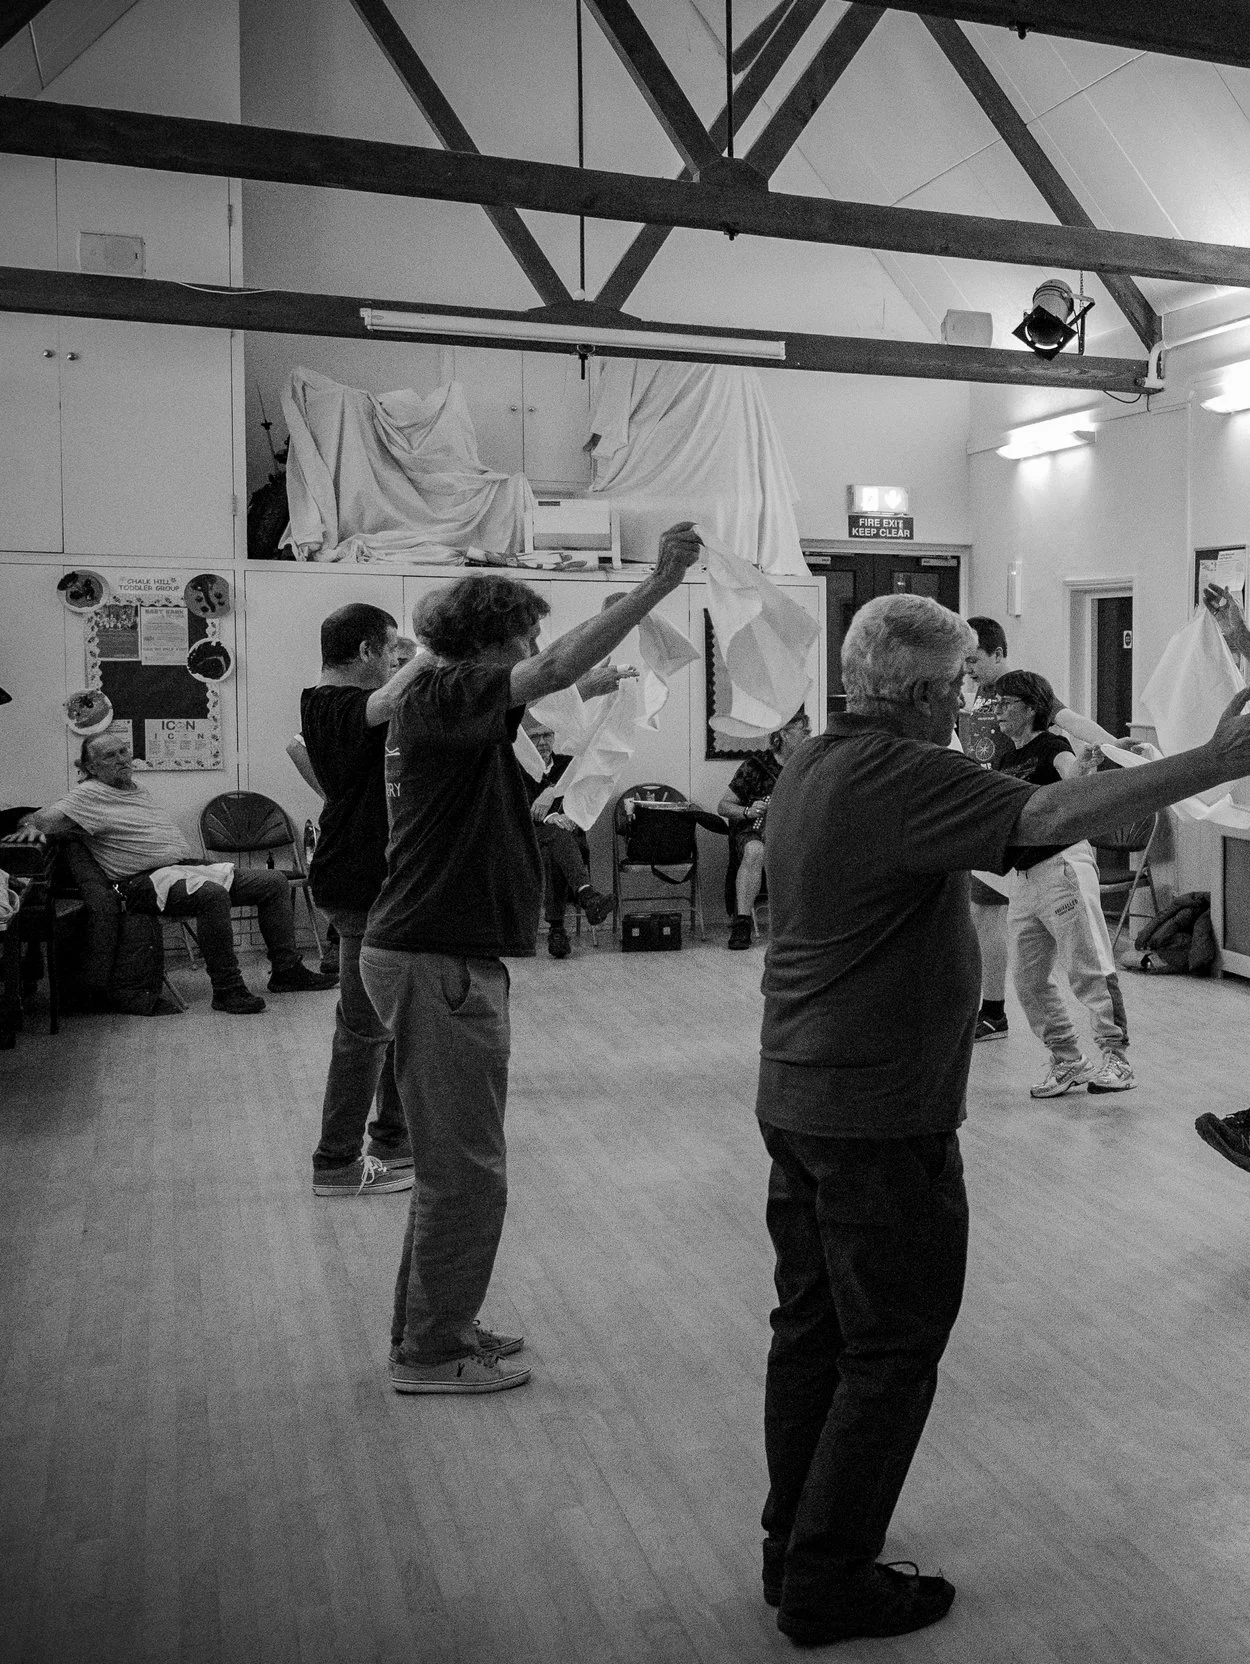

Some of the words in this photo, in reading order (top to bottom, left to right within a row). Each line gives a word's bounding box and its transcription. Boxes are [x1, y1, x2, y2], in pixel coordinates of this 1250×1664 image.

[859, 518, 880, 527] FIRE
[883, 519, 903, 528] EXIT
[852, 528, 877, 536] KEEP
[879, 528, 910, 537] CLEAR
